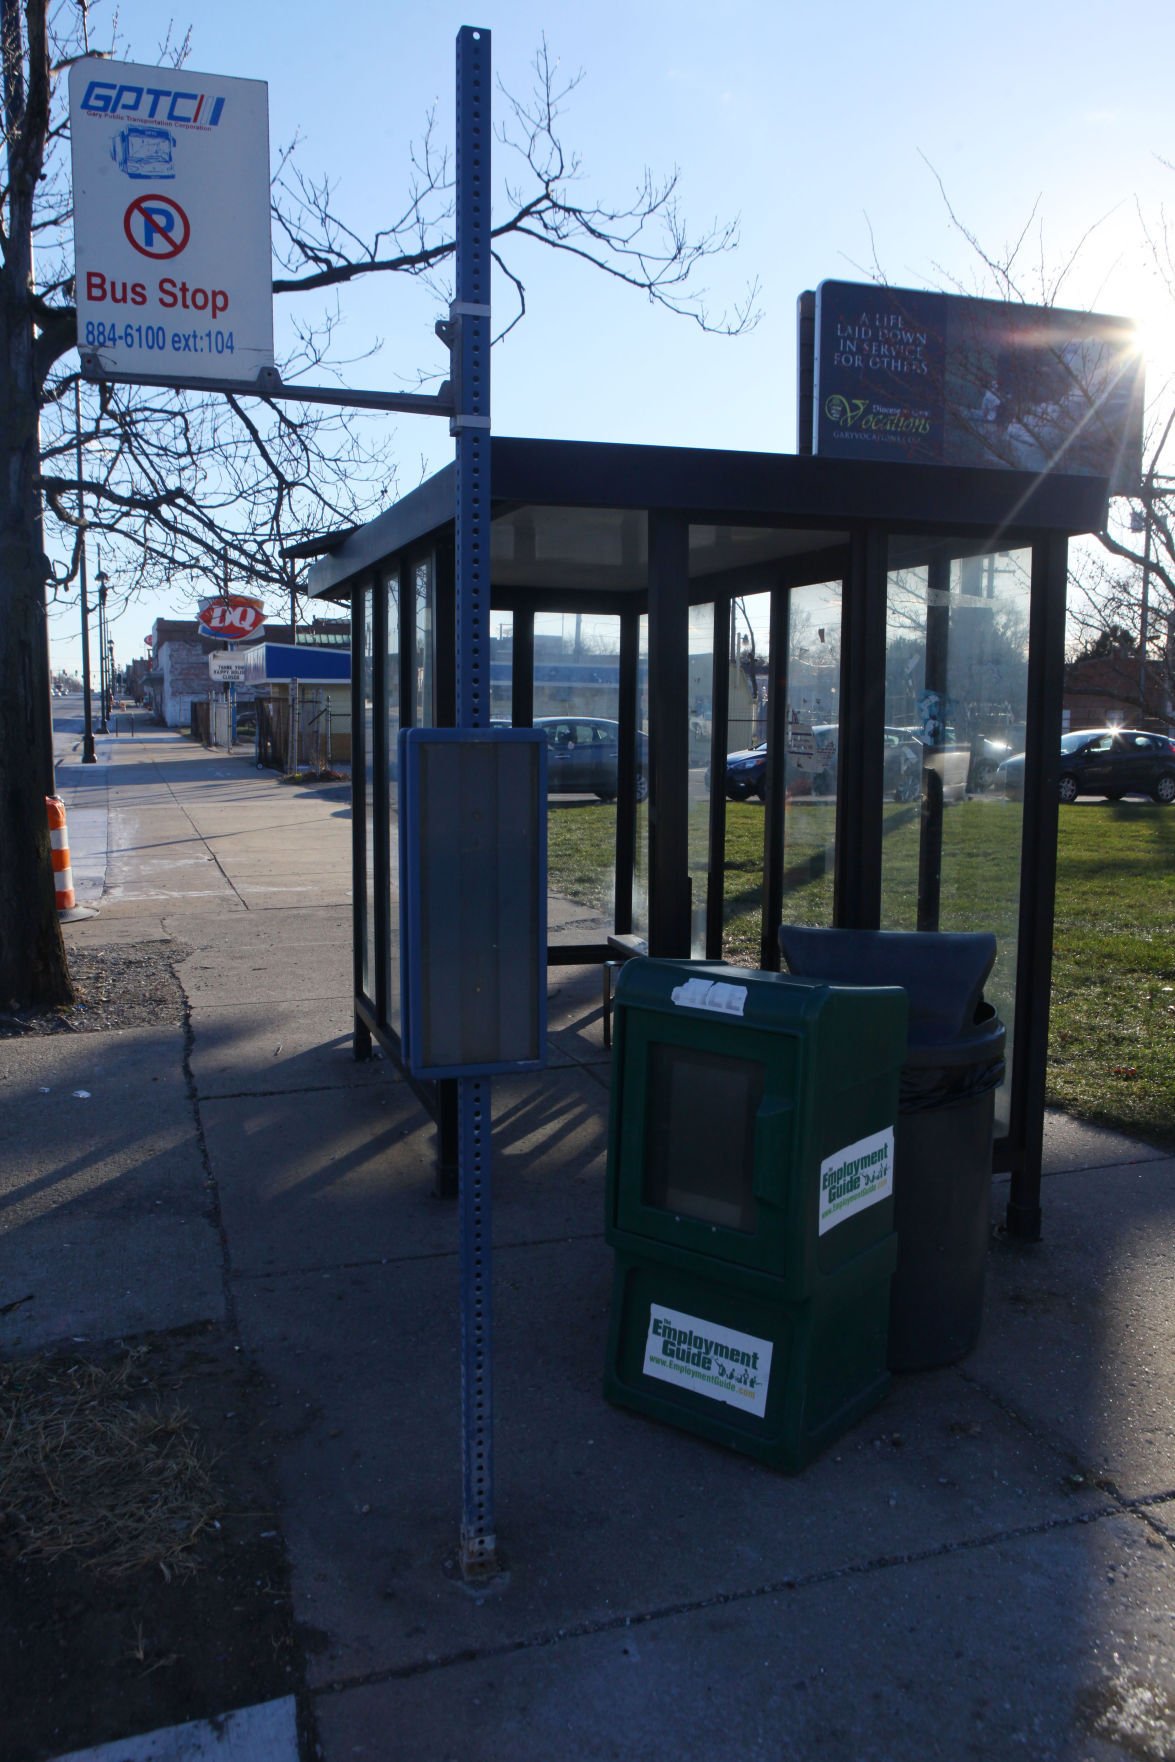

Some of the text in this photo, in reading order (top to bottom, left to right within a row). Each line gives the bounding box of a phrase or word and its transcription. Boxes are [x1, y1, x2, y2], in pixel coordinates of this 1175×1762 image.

[86, 110, 212, 132] Gary Public Transportation Corporation
[86, 271, 229, 319] Bus Stop
[836, 323, 928, 345] LAID DOWN
[859, 312, 870, 326] A
[85, 321, 235, 355] 884-6100 ext:104
[840, 338, 924, 359] IN SERVICE
[833, 352, 865, 368] FOR
[838, 399, 931, 434] Vocations
[209, 605, 256, 631] DQ
[822, 1142, 888, 1191] Employment
[828, 1174, 861, 1204] Guide
[652, 1318, 759, 1370] Employment
[661, 1339, 712, 1371] Guide
[649, 1354, 756, 1401] www.EmploymentGuide.com
